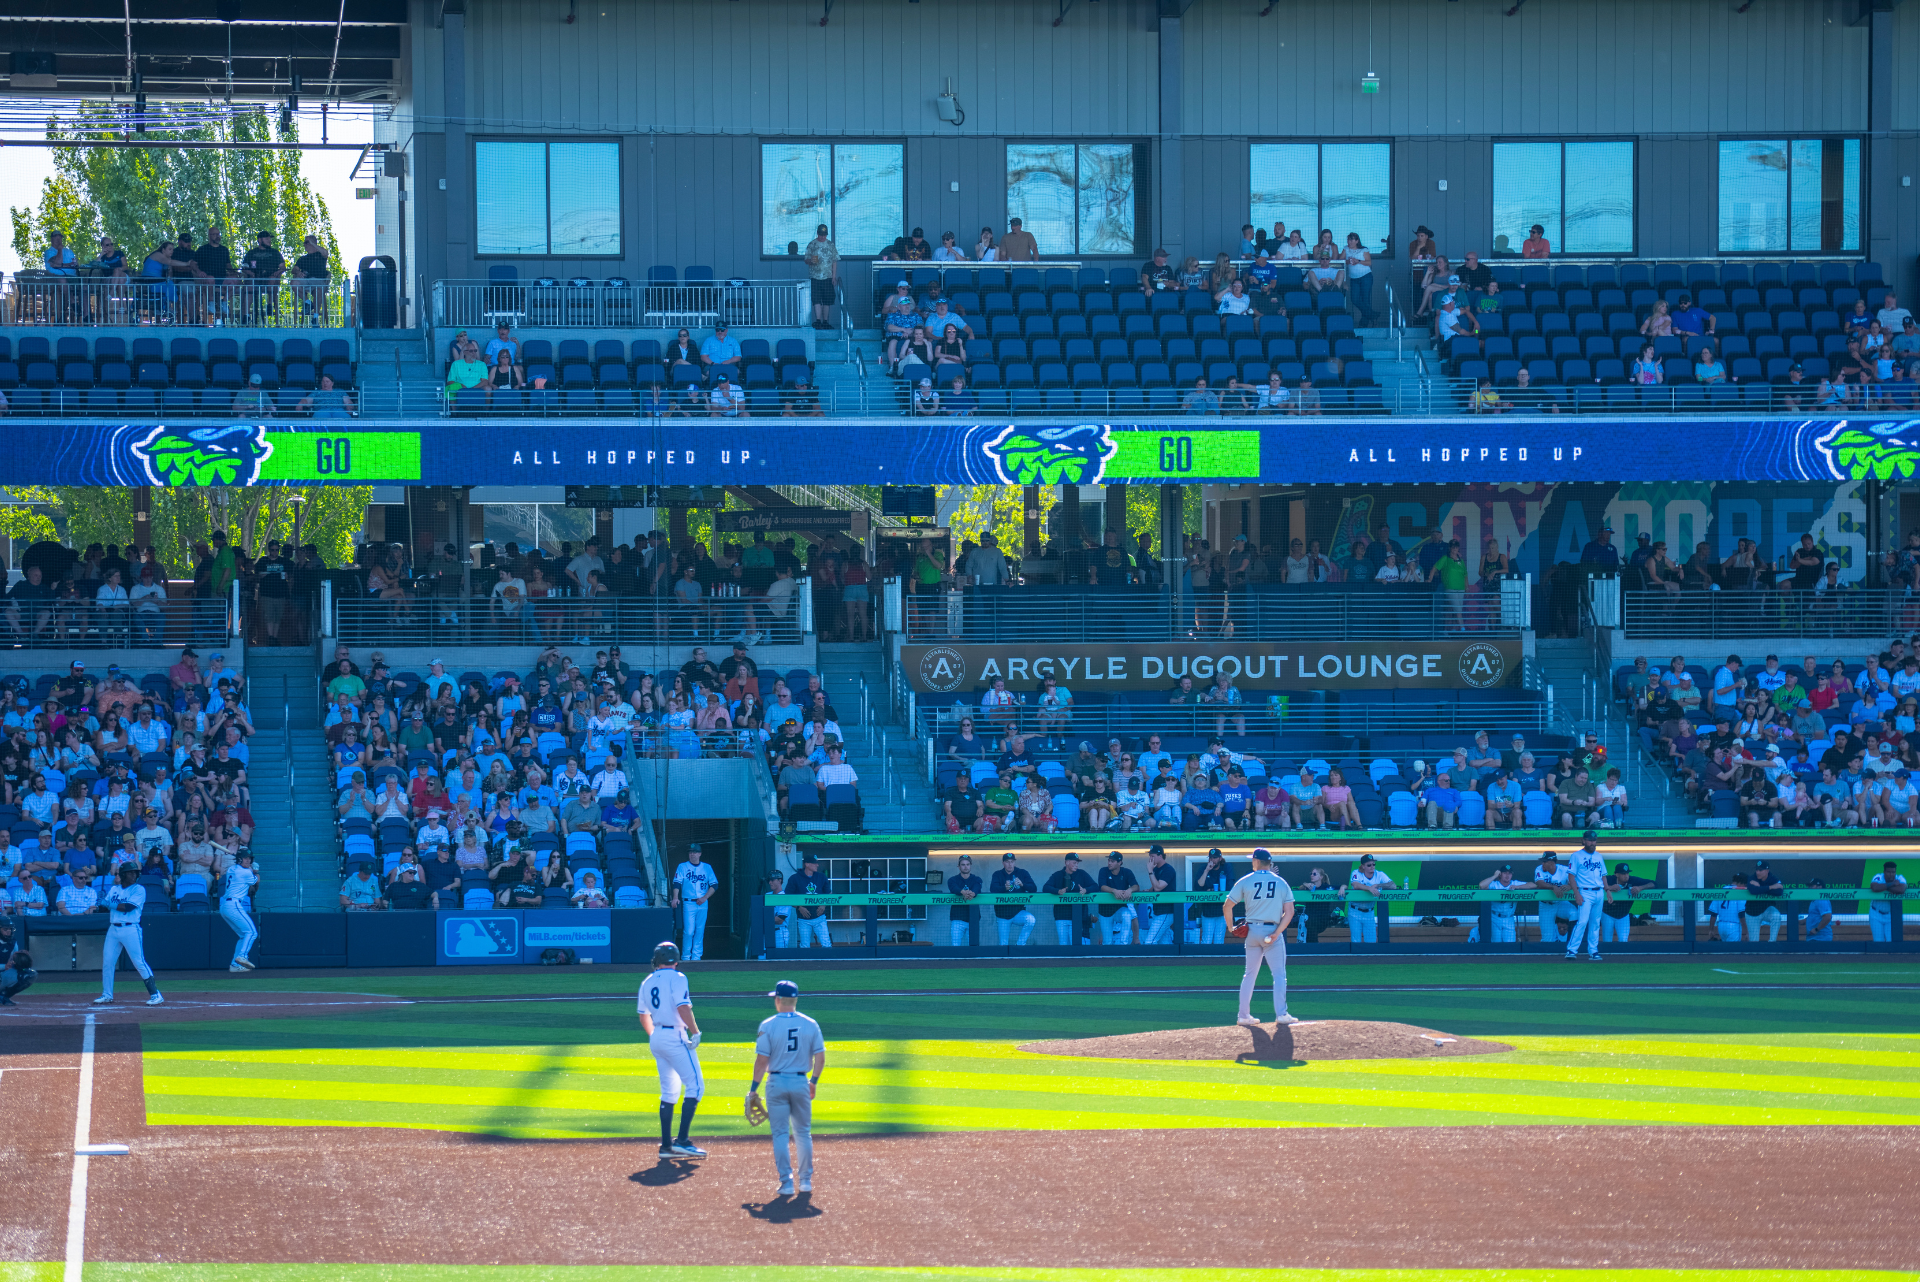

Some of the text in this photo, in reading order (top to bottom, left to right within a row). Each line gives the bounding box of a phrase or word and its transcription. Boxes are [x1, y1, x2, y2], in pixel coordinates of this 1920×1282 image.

[316, 437, 351, 475] GO
[513, 450, 750, 465] ALL HOPPED UP
[1159, 436, 1192, 472] GO
[1349, 446, 1583, 463] ALL HOPPED UP
[739, 512, 778, 529] Barley's
[979, 654, 1443, 681] ARGYLE DUGOUT LOUNGE
[686, 871, 706, 884] Hops
[1253, 881, 1277, 900] 29
[1691, 891, 1729, 899] TRUGREEN
[1819, 891, 1857, 899] TRUGREEN
[804, 896, 842, 904] TRUGREEN
[868, 896, 906, 904] TRUGREEN
[1059, 895, 1097, 903] TRUGREEN
[528, 931, 607, 942] MiLB.com/tickets
[650, 986, 661, 1010] 8
[786, 1027, 800, 1053] 5
